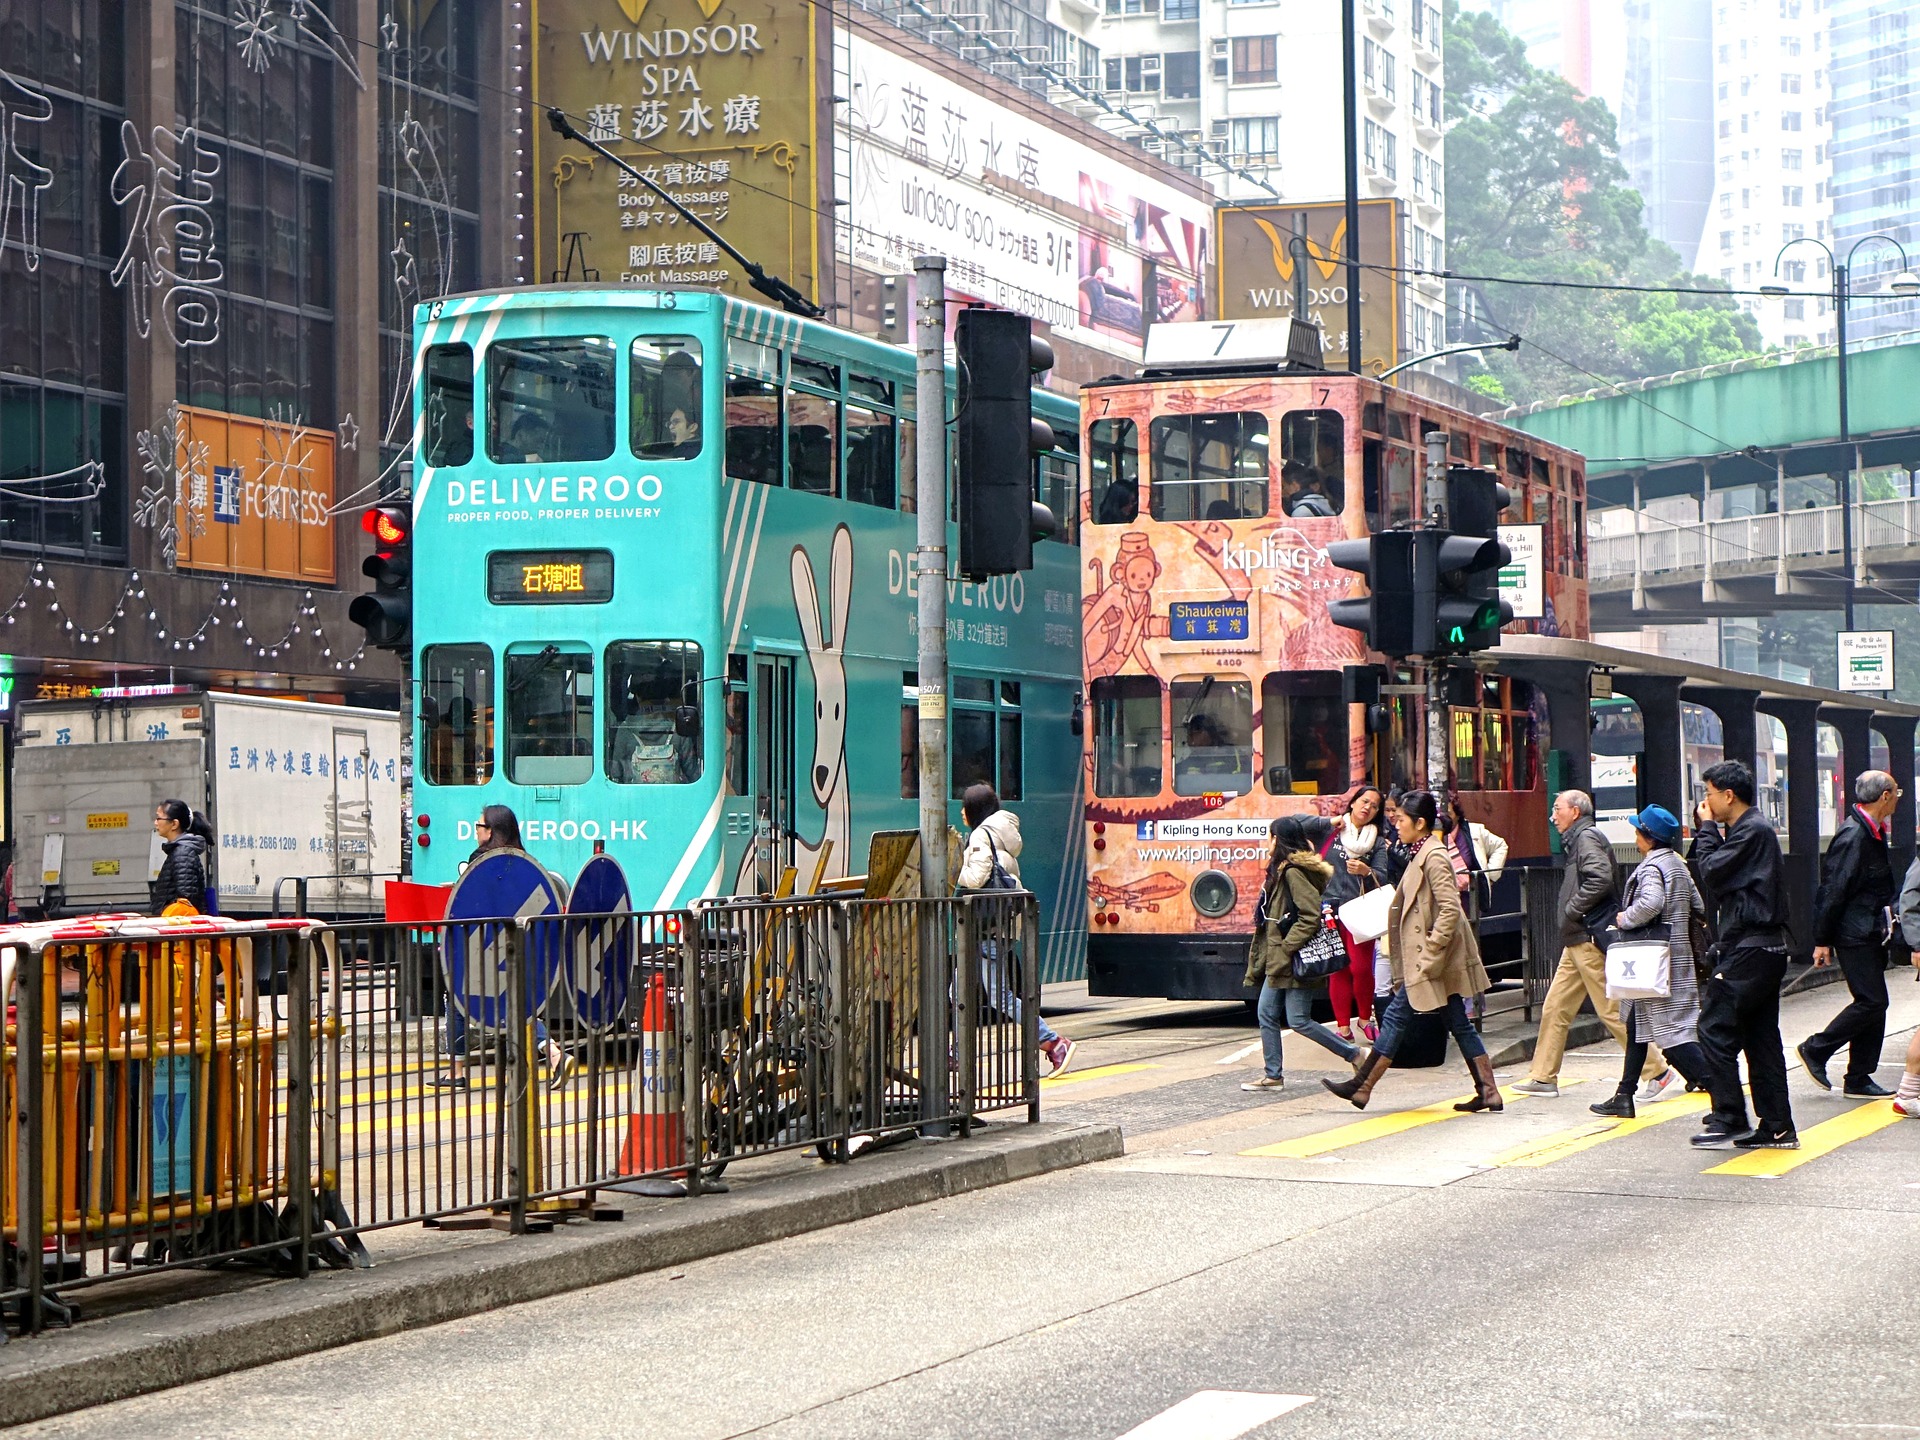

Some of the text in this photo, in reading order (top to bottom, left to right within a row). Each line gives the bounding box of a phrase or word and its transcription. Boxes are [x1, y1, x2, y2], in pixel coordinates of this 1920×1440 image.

[581, 23, 764, 63] WINDSOR
[641, 63, 703, 97] SPA
[618, 192, 657, 208] Body
[901, 176, 994, 252] windsor spa
[1047, 231, 1072, 276] 3/F
[620, 269, 729, 283] Foot Massage
[652, 291, 677, 310] 13
[426, 301, 443, 320] 13
[1211, 324, 1235, 356] 7
[1101, 398, 1110, 415] 7
[1319, 388, 1330, 406] 7
[447, 474, 663, 507] DELIVEROO
[245, 481, 329, 527] FORTRESS
[447, 507, 662, 523] PROPER FOOD, PROPER DELIVERY
[1222, 537, 1312, 577] kipling
[522, 563, 585, 592] 石塘咀
[888, 549, 1026, 614] DEVEROO
[1262, 577, 1361, 593] MAKE HAPPY
[1185, 619, 1242, 634] 筲箕灣
[1201, 648, 1256, 656] TELEPHONE
[1203, 796, 1223, 807] 106
[457, 819, 649, 841] DEROO.HK
[1162, 824, 1200, 838] Kipling
[1203, 824, 1233, 838] Hong
[1237, 823, 1267, 837] Kong
[259, 836, 278, 850] 2686
[279, 836, 297, 851] 1209
[1622, 961, 1636, 976] X
